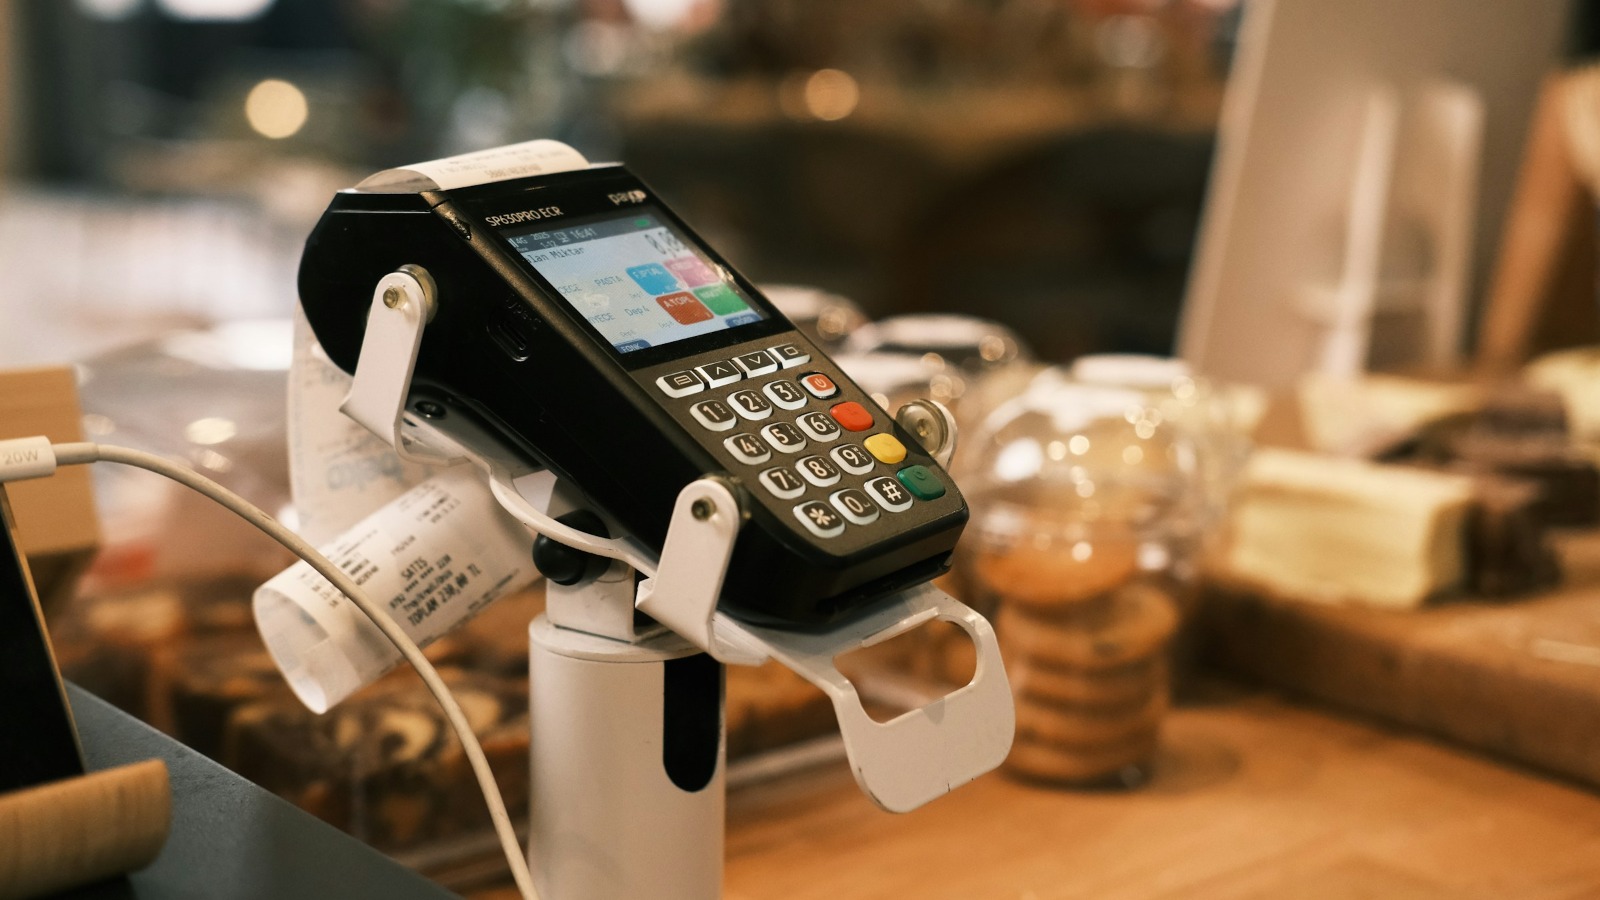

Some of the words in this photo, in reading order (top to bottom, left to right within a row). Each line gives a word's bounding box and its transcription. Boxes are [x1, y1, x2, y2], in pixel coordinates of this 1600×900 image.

[485, 209, 540, 227] SP630PRO
[540, 206, 564, 219] ECR
[570, 228, 597, 239] 16:41
[549, 247, 584, 259] Miktar
[594, 275, 623, 286] PASTA
[625, 306, 643, 317] Dep
[774, 384, 793, 400] 3
[740, 395, 759, 411] 2
[703, 405, 720, 421] 1
[810, 416, 827, 432] 6
[771, 428, 789, 444] 5
[740, 438, 758, 454] 4
[4, 449, 39, 465] 20W
[842, 449, 859, 465] 9
[808, 461, 828, 477] 8
[771, 471, 789, 489] 7
[882, 481, 902, 501] #
[844, 496, 864, 513] 0
[467, 563, 482, 577] TL
